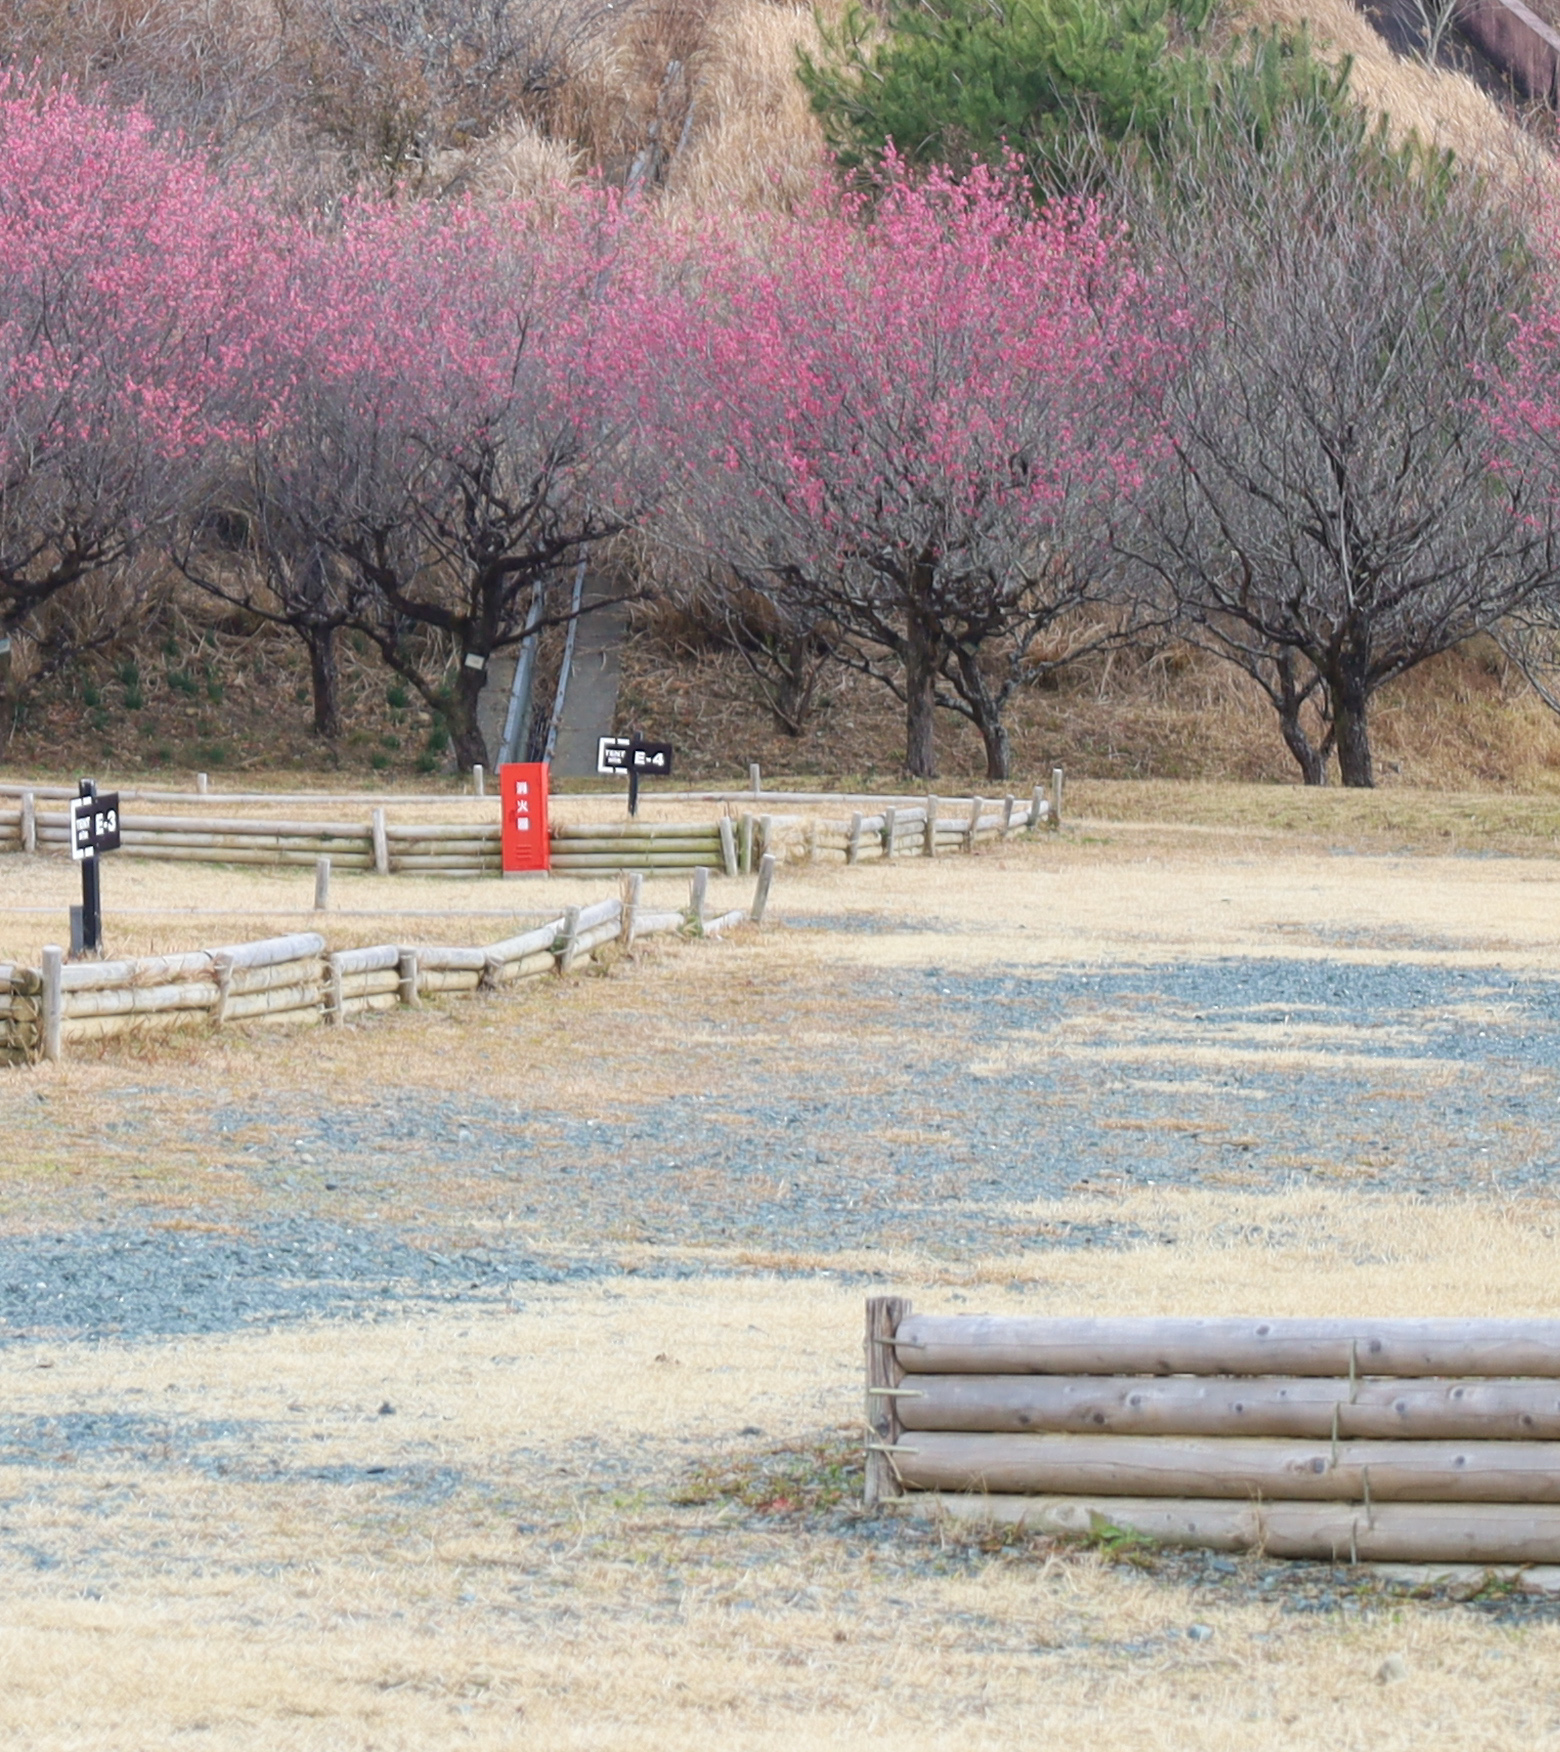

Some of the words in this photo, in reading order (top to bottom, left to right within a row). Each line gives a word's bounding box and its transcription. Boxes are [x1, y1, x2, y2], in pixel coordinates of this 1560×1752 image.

[605, 750, 626, 758] TENT
[634, 750, 664, 766] E-4
[95, 810, 116, 836] E-3
